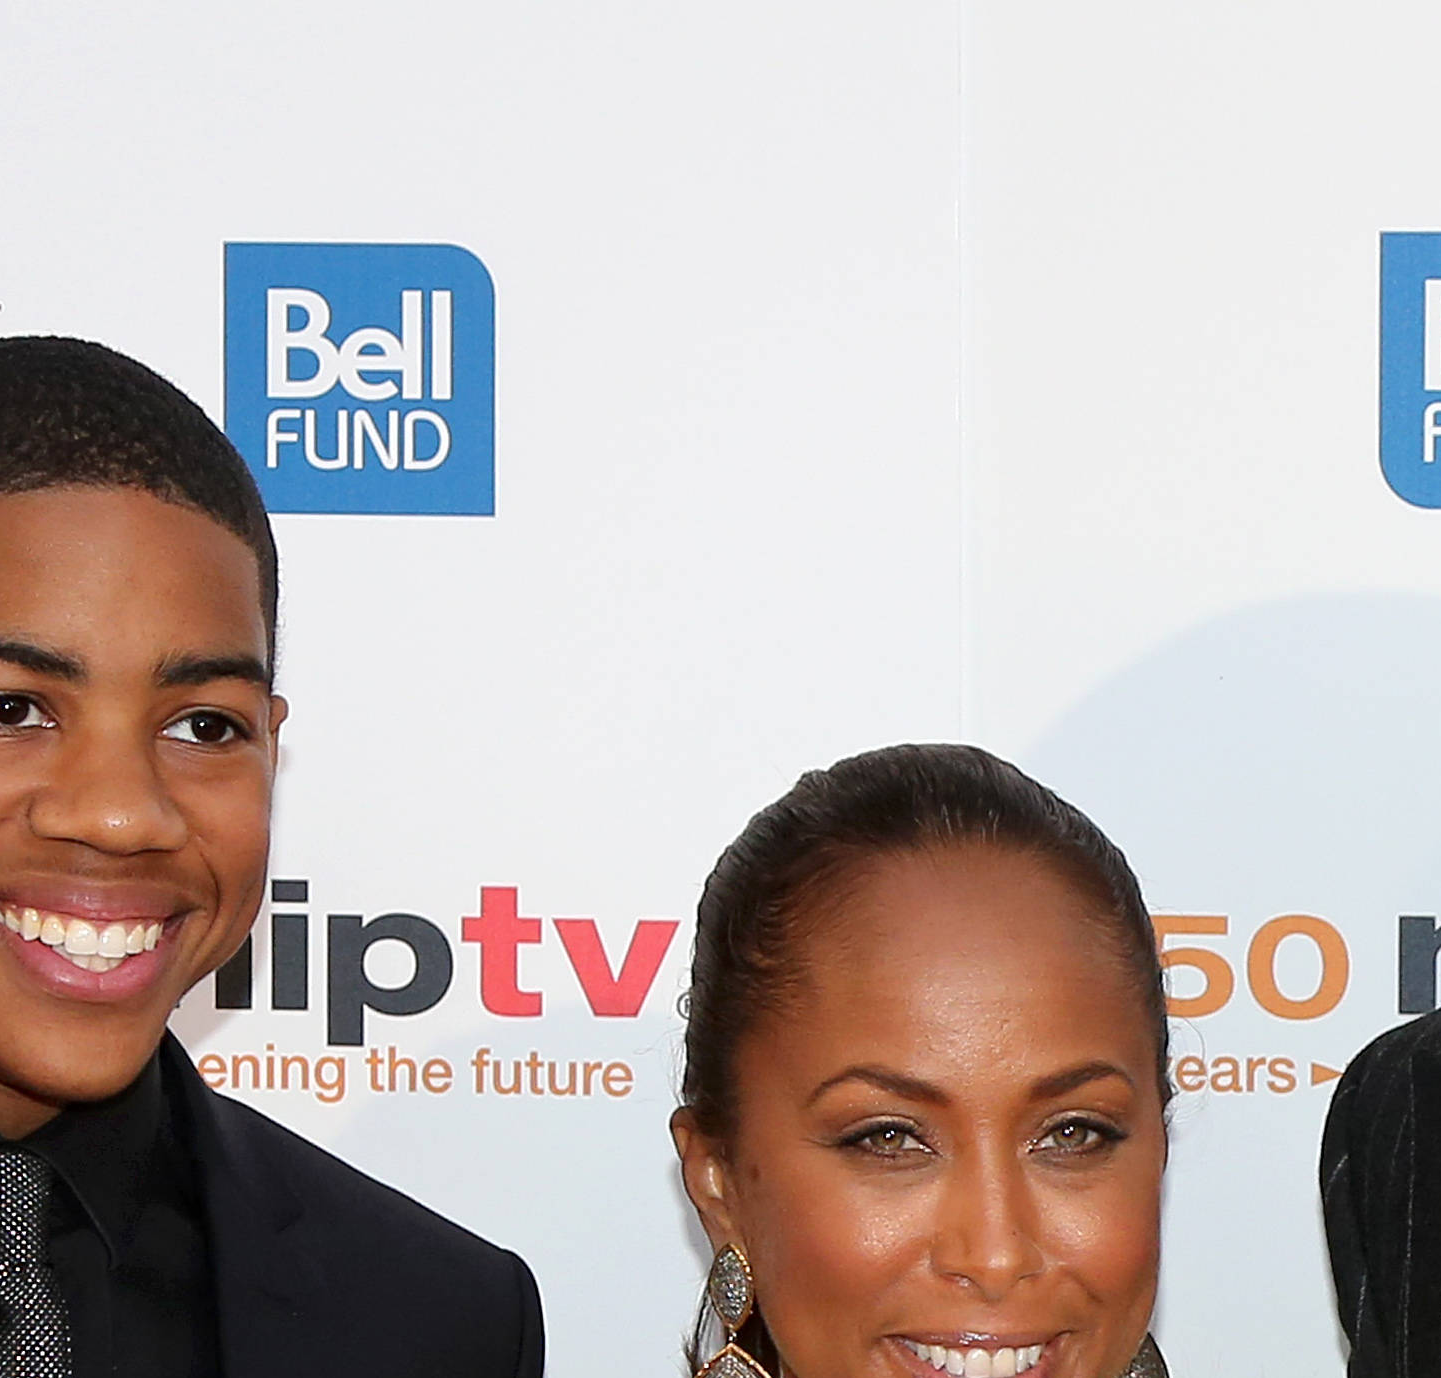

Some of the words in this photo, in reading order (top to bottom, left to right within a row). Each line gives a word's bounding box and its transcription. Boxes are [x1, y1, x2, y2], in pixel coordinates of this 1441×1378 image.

[266, 288, 452, 401] Bell
[266, 408, 450, 470] FUND
[215, 880, 680, 1047] iptv
[1153, 914, 1349, 1020] 50
[197, 1043, 346, 1101] ening
[364, 1046, 453, 1094] the
[470, 1047, 634, 1097] future
[1174, 1055, 1297, 1094] ears
